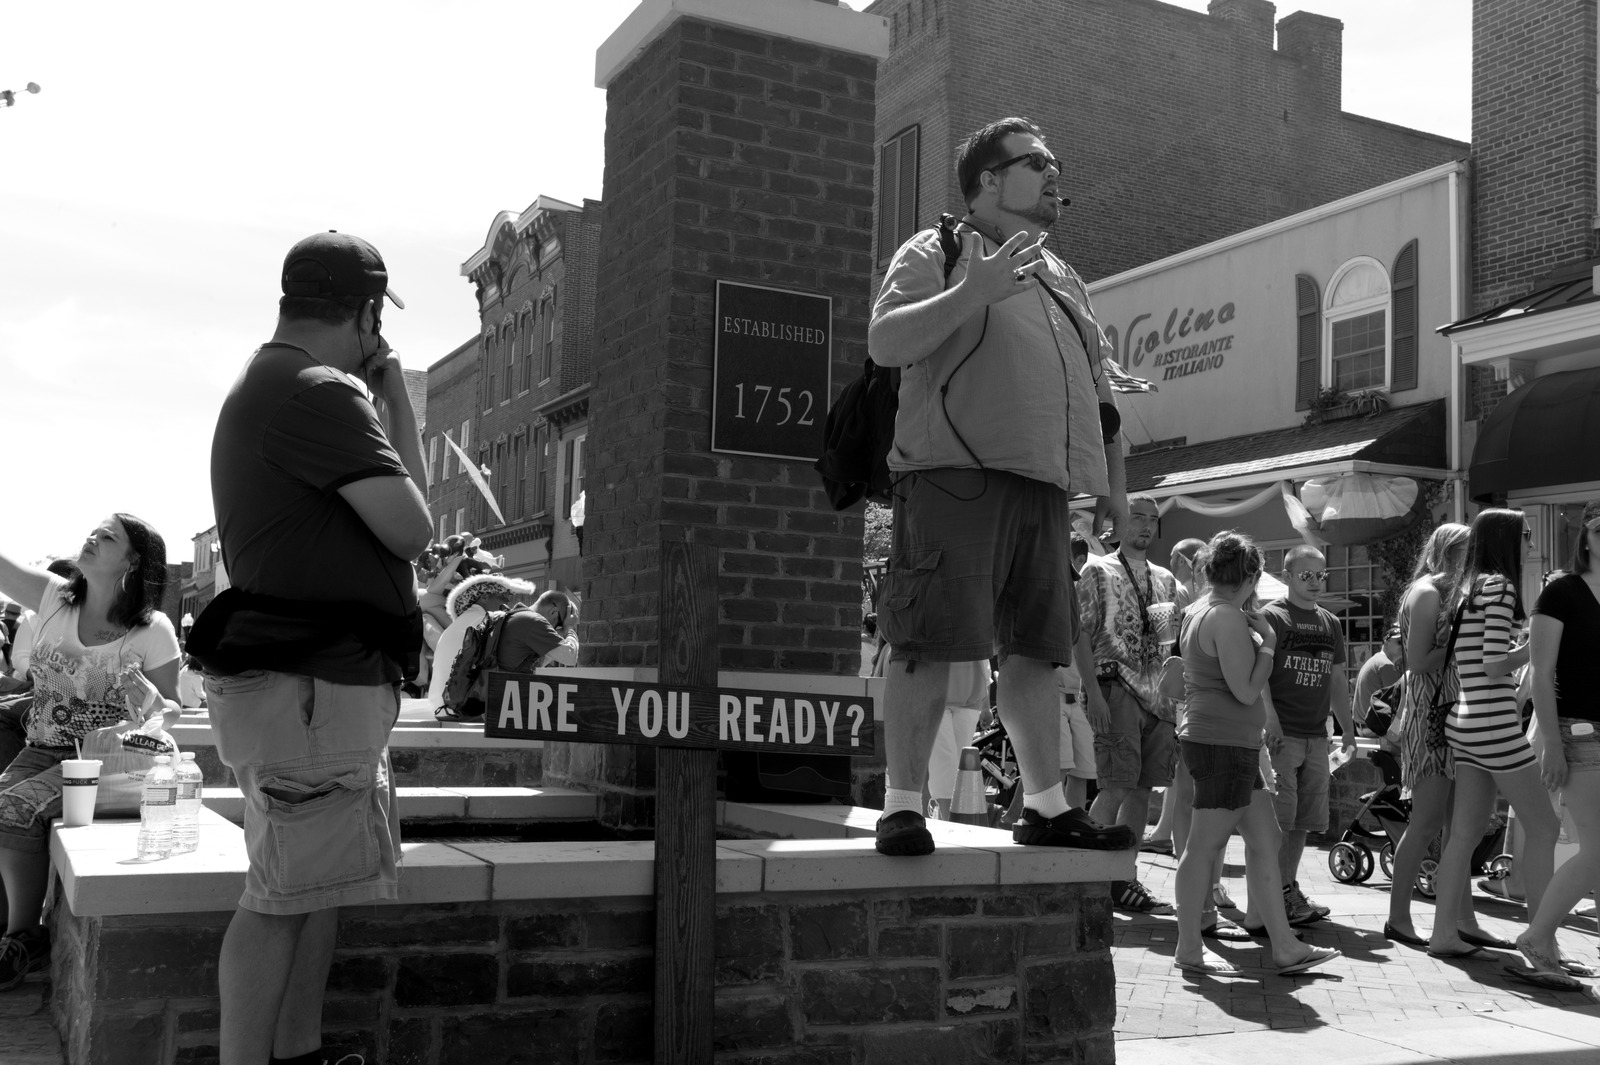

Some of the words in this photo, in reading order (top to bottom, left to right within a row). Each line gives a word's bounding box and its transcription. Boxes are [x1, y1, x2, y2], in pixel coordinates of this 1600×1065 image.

[723, 316, 825, 345] ESTABLISHED
[1103, 302, 1235, 372] Violino
[1153, 335, 1234, 368] RISTORANTE
[1162, 354, 1224, 381] ITALIANO
[735, 382, 814, 426] 1752
[498, 680, 578, 732] ARE
[611, 687, 690, 739] YOU
[719, 694, 865, 747] READY?
